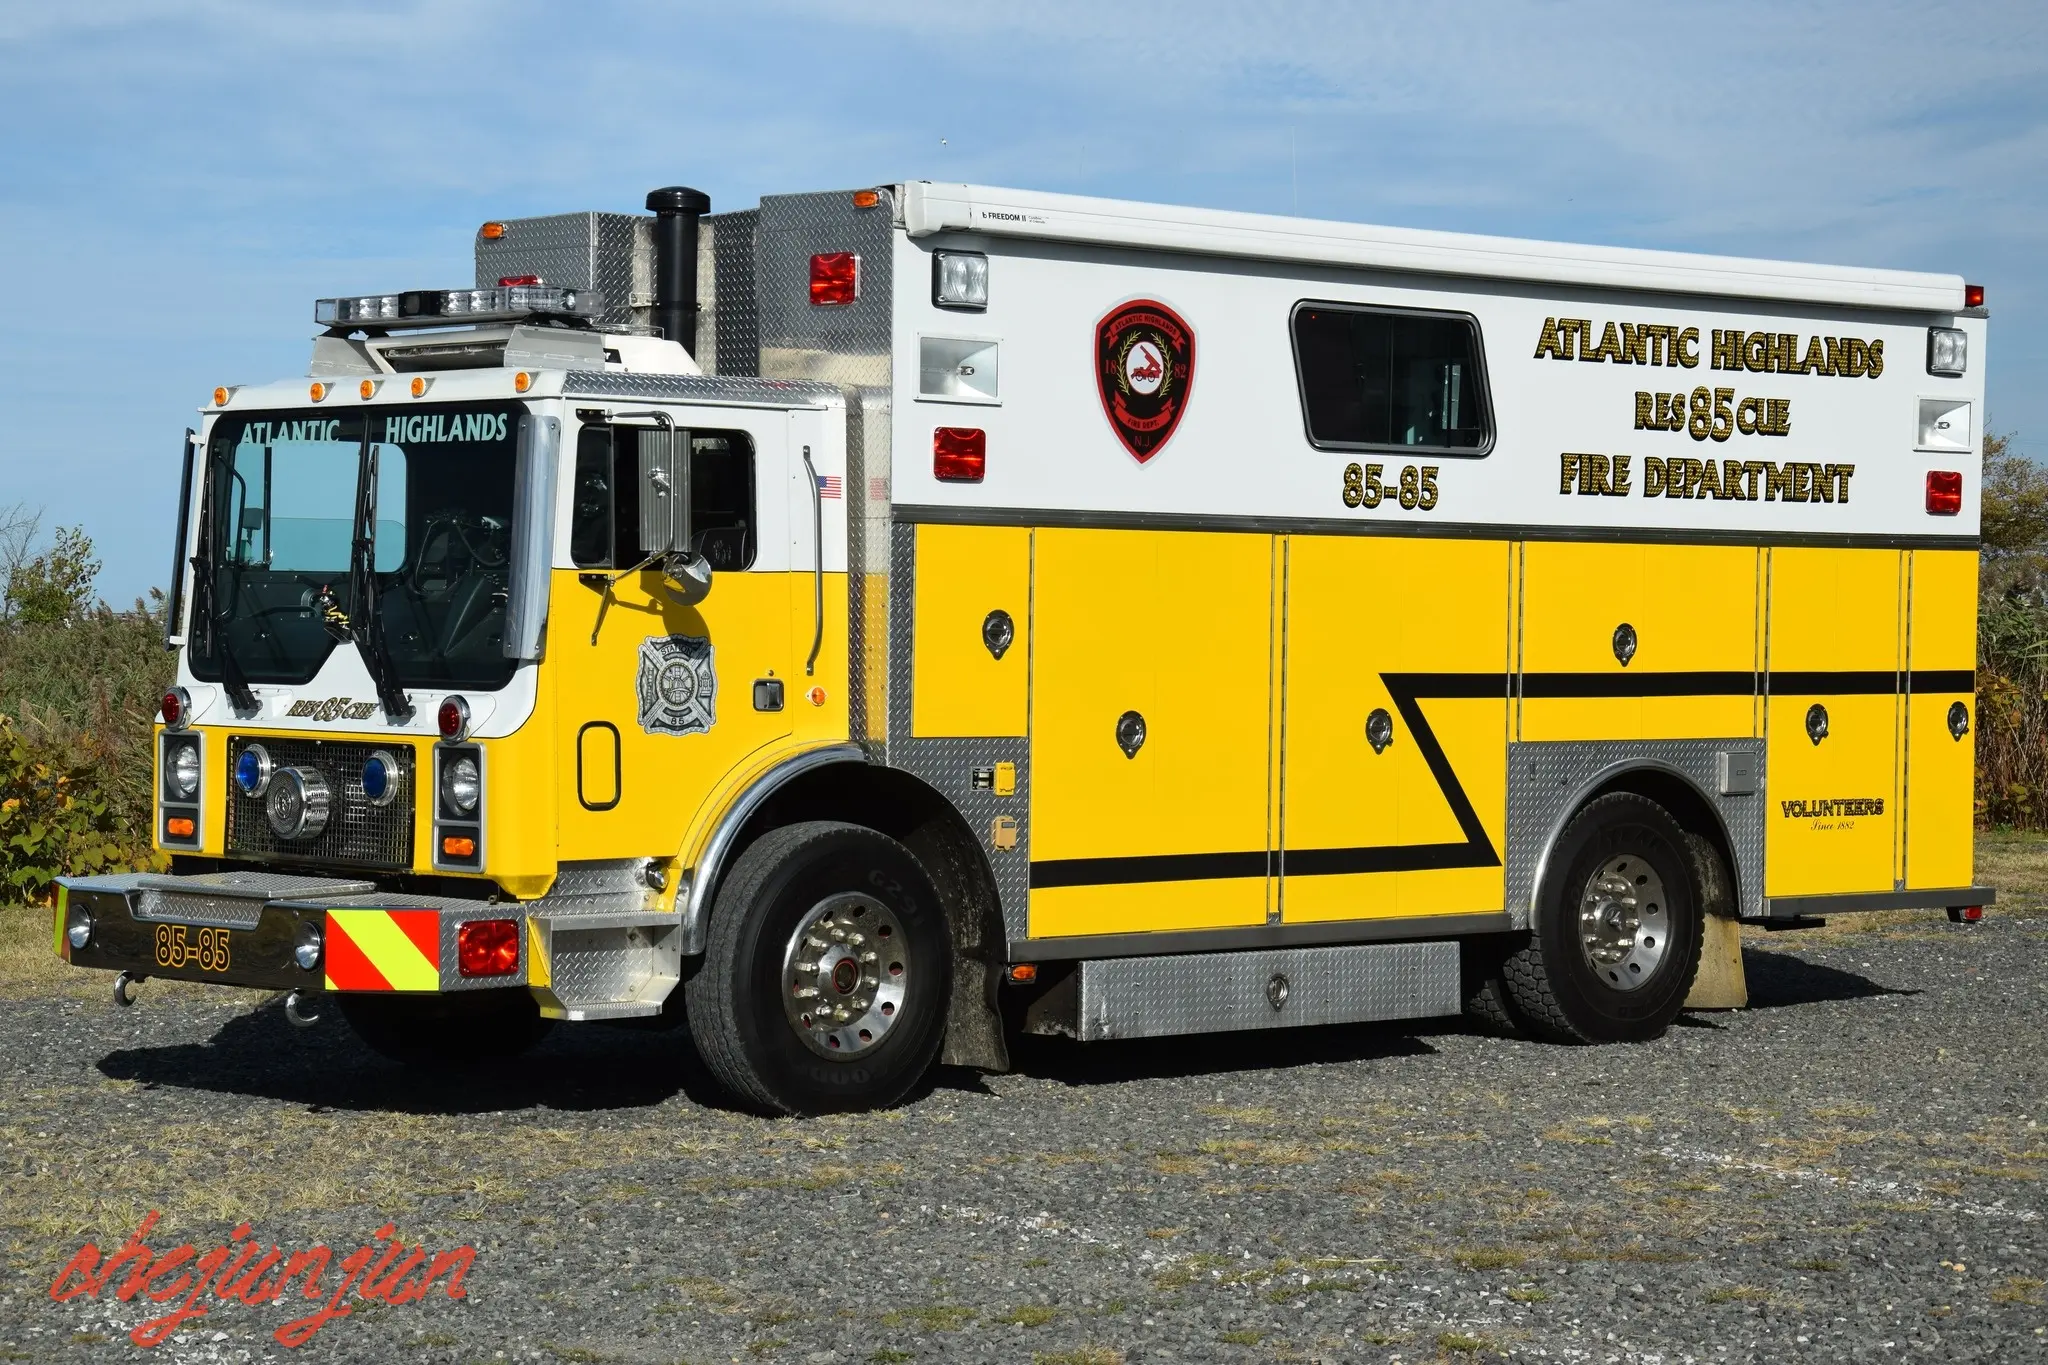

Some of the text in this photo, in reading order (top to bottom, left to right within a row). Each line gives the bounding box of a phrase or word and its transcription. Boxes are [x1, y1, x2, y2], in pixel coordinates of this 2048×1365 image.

[988, 212, 1020, 222] FREEDOM
[1114, 314, 1177, 336] ATLANTIC HIGHLANDS
[1534, 317, 1885, 380] ATLANTIC HIGHLANDS
[1105, 360, 1187, 379] 18 82
[240, 412, 508, 448] ATLANTIC HIGHLANDS
[1128, 418, 1141, 429] FIRE
[1135, 435, 1152, 448] N.J.
[1342, 462, 1440, 512] 85-85
[1559, 452, 1856, 505] FIRE DEPARTMENT
[660, 642, 693, 657] STATION
[671, 717, 685, 726] 85
[1780, 798, 1885, 819] VOLUNTEERS
[1811, 819, 1855, 831] Since 1882
[155, 924, 231, 972] 85-85
